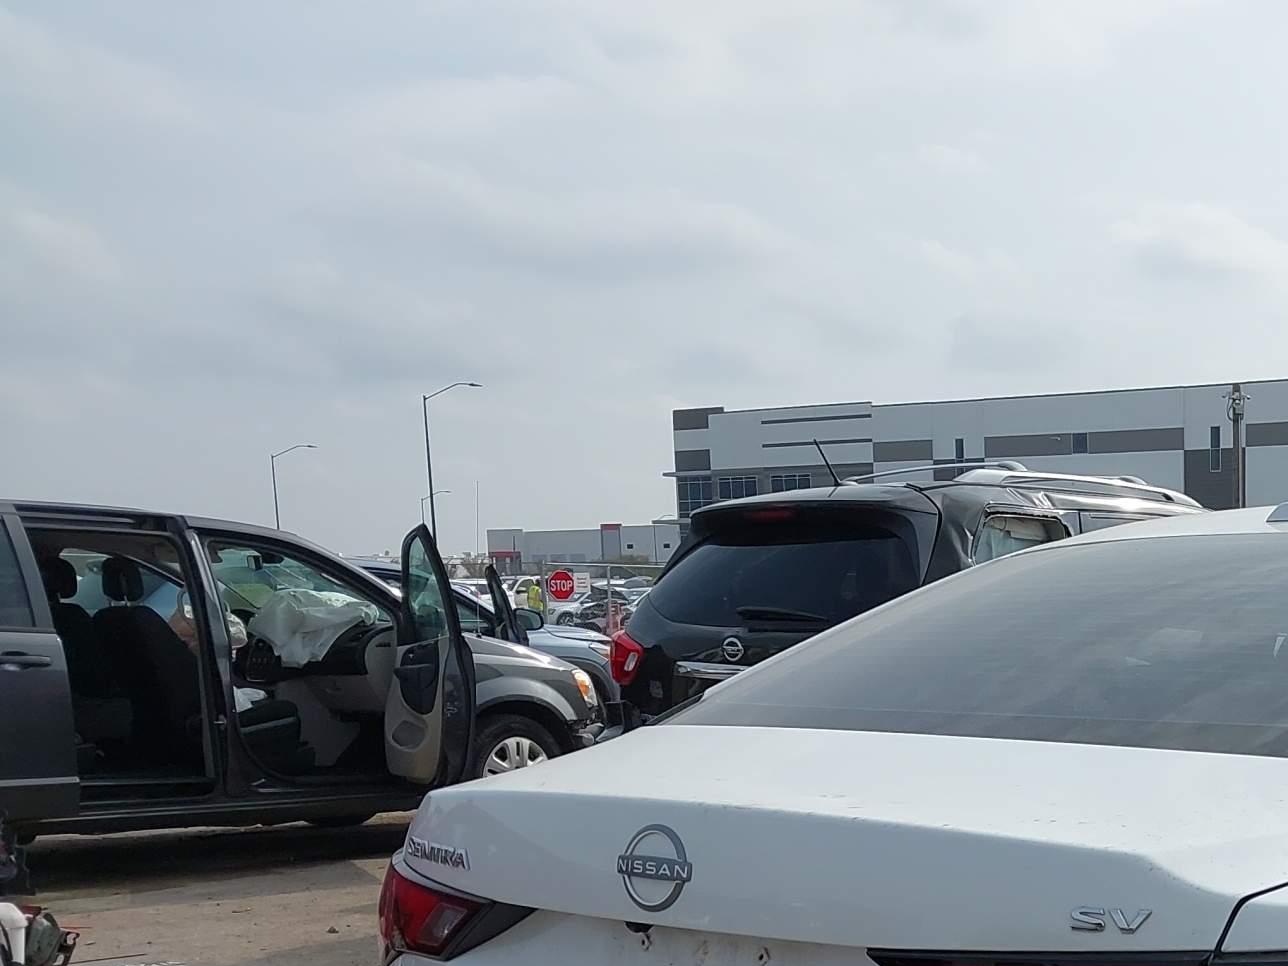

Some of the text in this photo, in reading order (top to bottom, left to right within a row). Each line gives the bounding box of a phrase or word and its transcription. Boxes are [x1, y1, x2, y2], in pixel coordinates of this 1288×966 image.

[550, 579, 573, 592] STOP
[407, 836, 471, 872] SENTRA
[618, 858, 688, 879] NISSAN
[1070, 905, 1153, 934] SV
